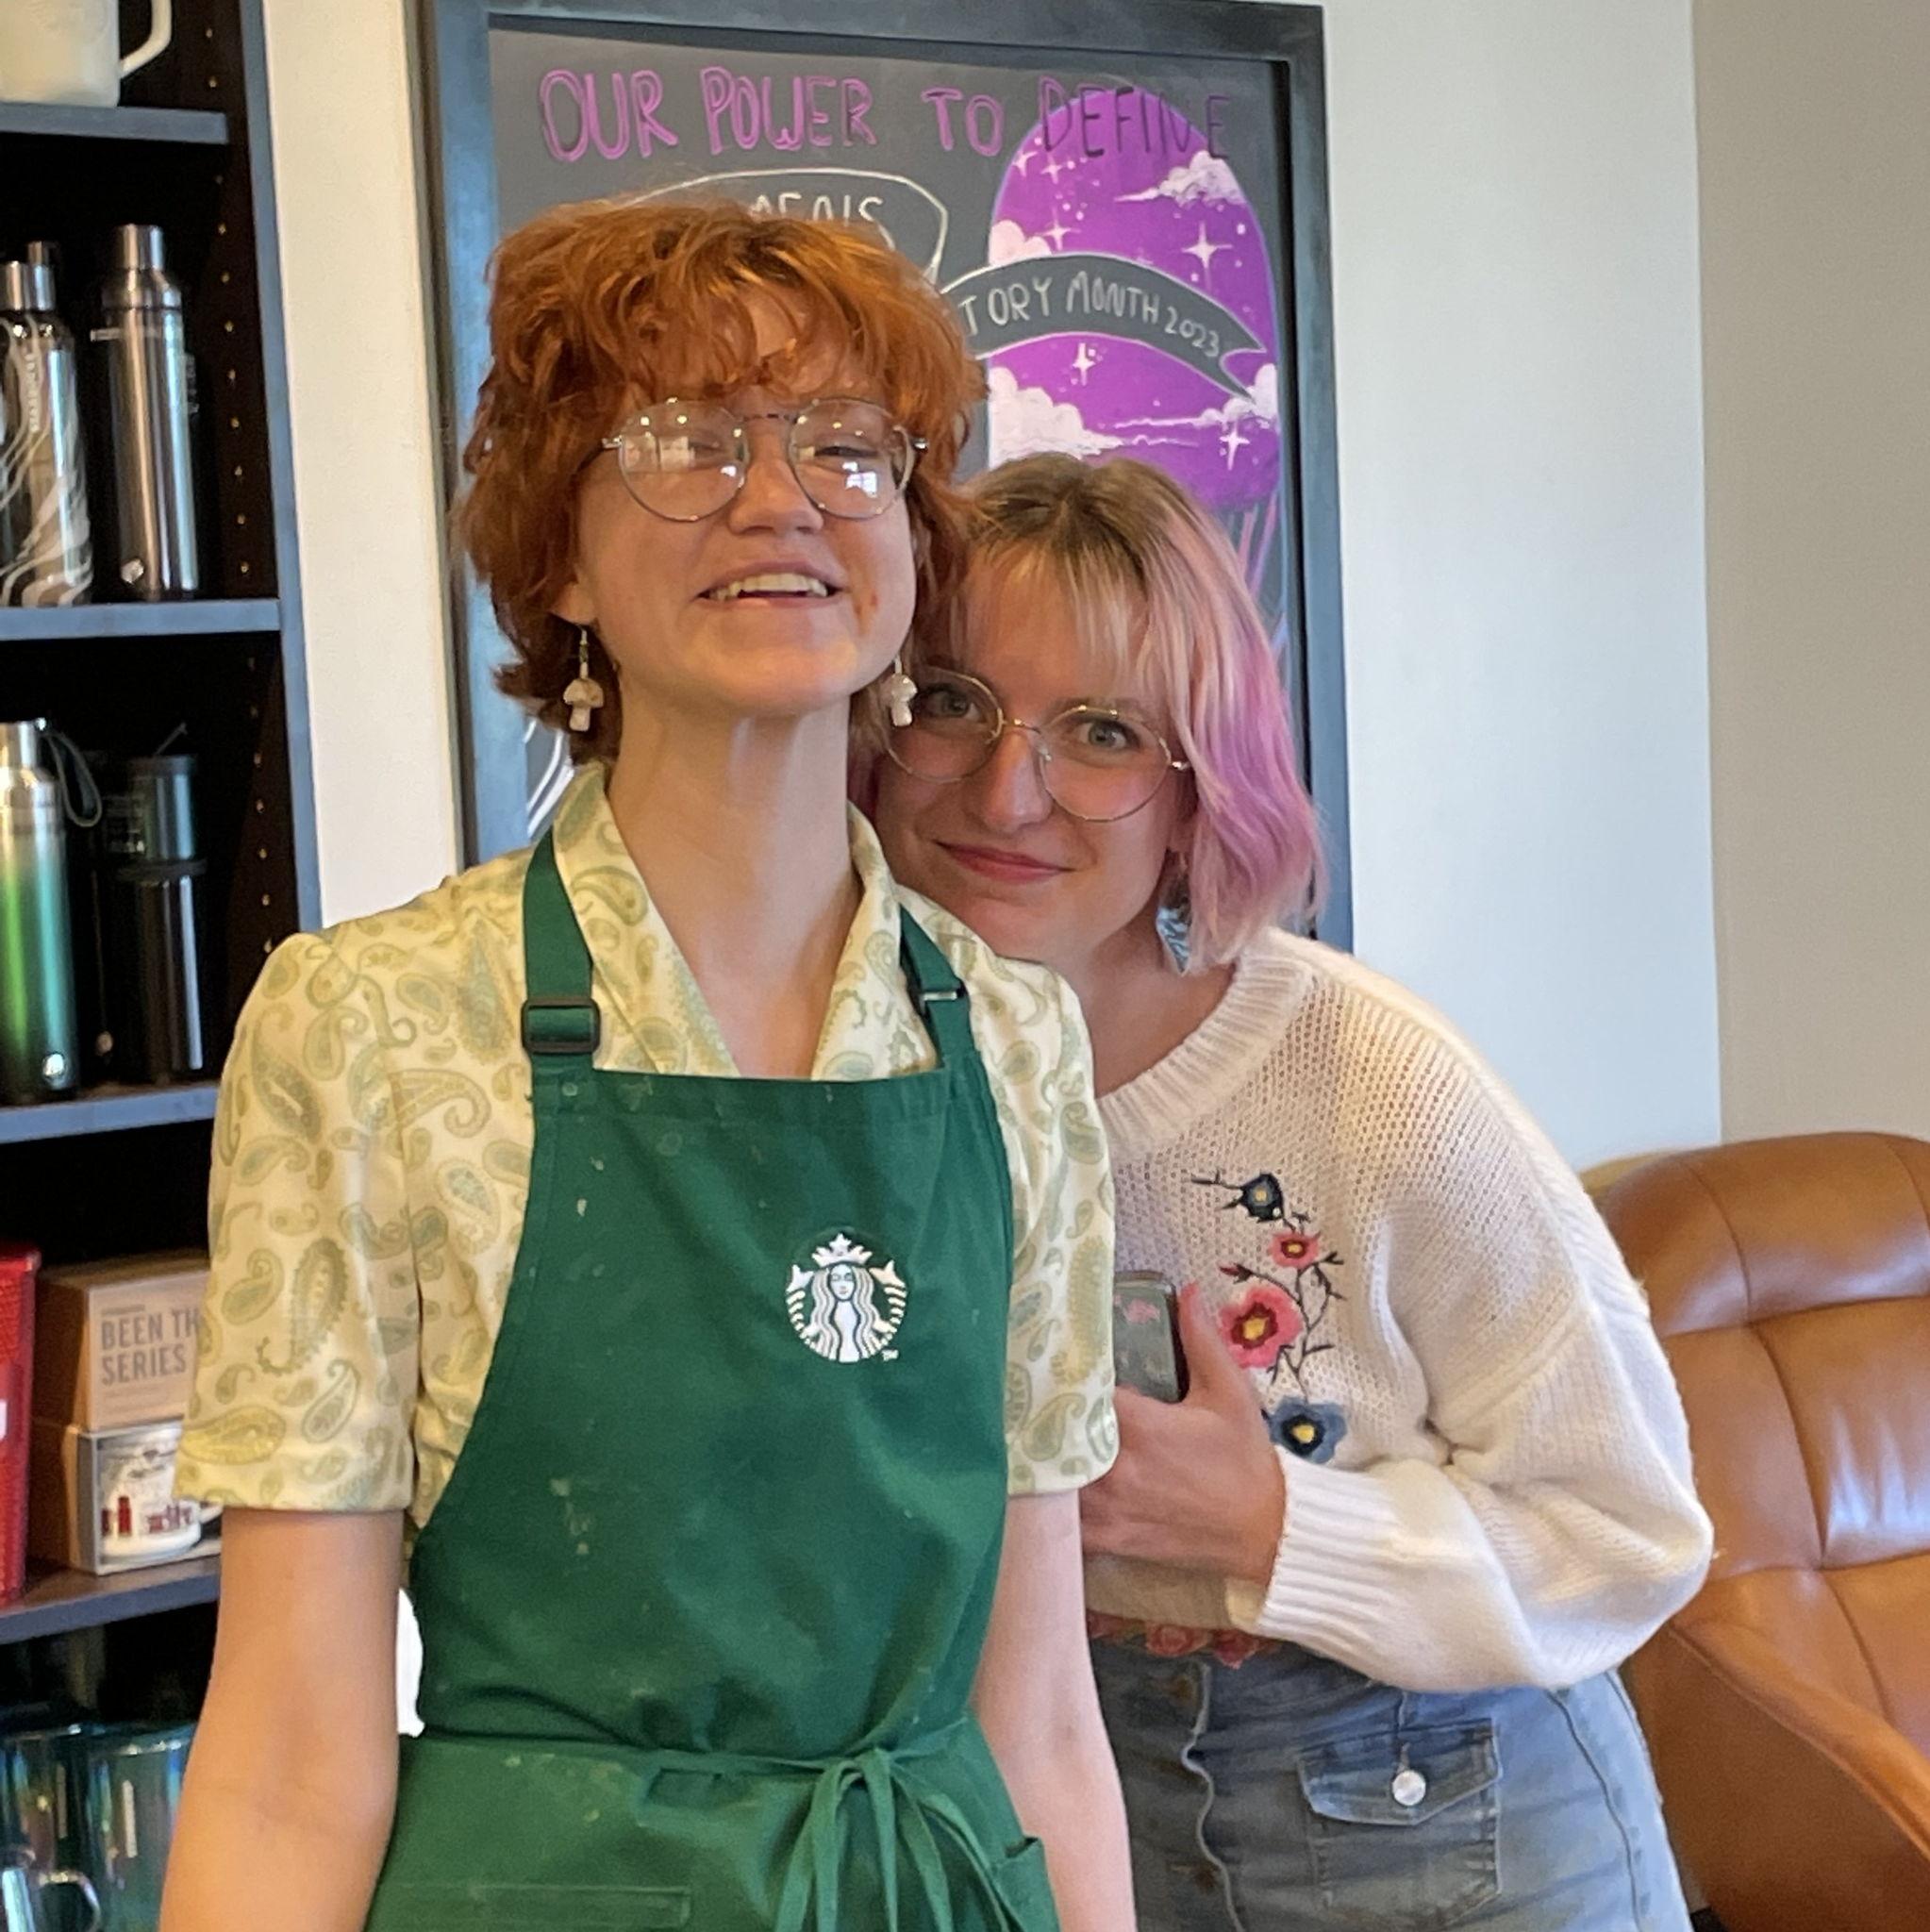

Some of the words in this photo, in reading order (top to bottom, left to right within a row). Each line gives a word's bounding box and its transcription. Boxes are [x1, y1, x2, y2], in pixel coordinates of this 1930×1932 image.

[539, 69, 678, 161] OUR
[699, 65, 877, 156] POWER
[921, 85, 1005, 158] TO
[1039, 75, 1230, 159] DEFINE
[957, 275, 1053, 335] TORY
[1065, 270, 1159, 325] MONTH
[1163, 305, 1221, 358] 2023
[101, 1312, 163, 1351] BEEN
[171, 1307, 200, 1339] TH
[101, 1342, 187, 1387] SERIES
